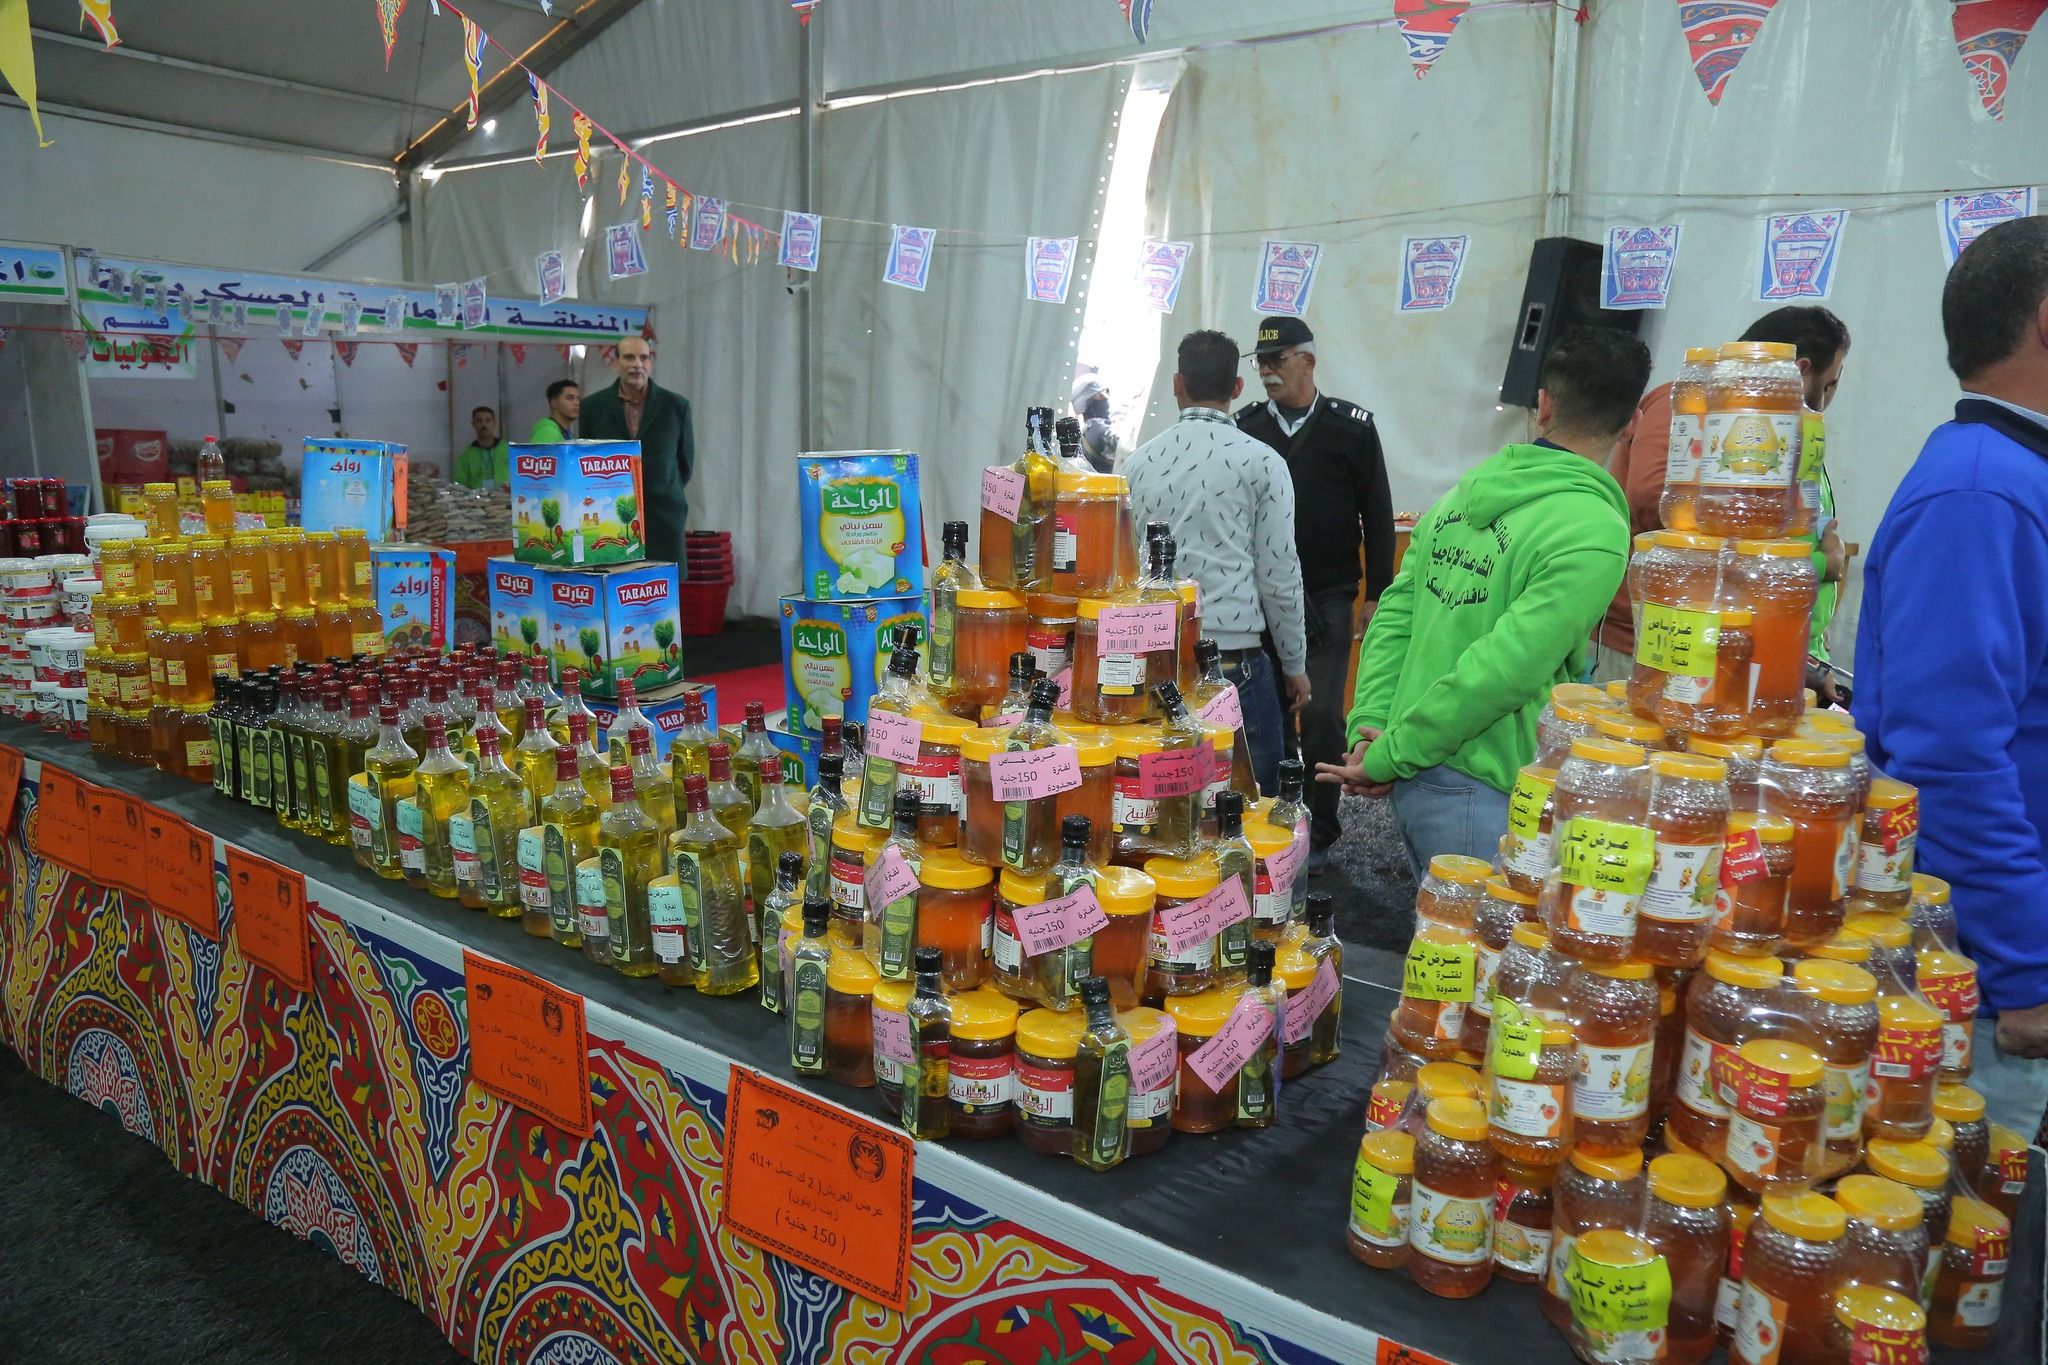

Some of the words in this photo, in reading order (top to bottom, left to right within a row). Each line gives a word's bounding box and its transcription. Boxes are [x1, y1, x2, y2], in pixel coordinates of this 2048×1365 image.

[103, 316, 169, 330] قسم
[507, 305, 629, 331] المنطقة
[521, 458, 553, 474] تبارك
[582, 458, 630, 473] TABARAK
[831, 487, 895, 512] الواحة
[839, 522, 860, 531] نباتي
[861, 522, 883, 531] سمن
[500, 576, 528, 591] تبارك
[557, 586, 588, 602] تبارك
[619, 583, 667, 600] TABARAK
[1109, 610, 1140, 620] خاص
[1142, 609, 1163, 619] عرض
[1153, 623, 1169, 633] لفترة
[799, 629, 841, 656] الواحة
[1147, 639, 1171, 648] محدودة
[804, 662, 818, 671] نباتي
[819, 664, 834, 672] سمن
[659, 703, 708, 730] TABAK
[884, 716, 909, 727] عرض
[901, 735, 914, 745] لفترة
[892, 749, 915, 761] محدودة
[998, 756, 1026, 767] خاص
[1029, 751, 1056, 764] عرض
[1151, 752, 1185, 763] خاص
[1052, 763, 1070, 775] لفترة
[1047, 780, 1077, 792] محدودة
[1589, 834, 1629, 850] عرض
[1674, 851, 1696, 860] HONEY
[884, 867, 900, 882] لفترة
[1596, 870, 1625, 884] محدودة
[885, 881, 912, 898] محدودة
[1205, 889, 1226, 908] عرض
[1220, 897, 1236, 912] لفترة
[1024, 907, 1051, 920] خاص
[1052, 900, 1078, 914] عرض
[1078, 904, 1096, 919] لفترة
[1171, 904, 1202, 921] خاص
[662, 915, 681, 923] محدودة
[1077, 916, 1107, 936] محدودة
[1218, 911, 1243, 928] محدودة
[1427, 952, 1462, 967] عرض
[1436, 970, 1462, 980] لفترة
[1436, 985, 1462, 995] محدودة
[1284, 994, 1309, 1015] خاص
[1225, 1013, 1243, 1039] عرض
[1245, 1013, 1262, 1031] لفترة
[1250, 1021, 1274, 1047] محدودة
[1504, 1029, 1528, 1041] لفترة
[1137, 1038, 1165, 1061] خاص
[1197, 1037, 1224, 1063] خاص
[1502, 1045, 1525, 1058] محدودة
[1601, 1053, 1622, 1062] HONEY
[1714, 1054, 1745, 1071] خاص
[1745, 1067, 1779, 1087] عرض
[1749, 1086, 1779, 1102] لفترة
[775, 1163, 792, 1179] عسل
[797, 1171, 806, 1184] ك
[808, 1178, 814, 1189] 2
[820, 1205, 839, 1221] زيت
[855, 1198, 884, 1217] عرض
[813, 1225, 837, 1247] 150
[1609, 1280, 1647, 1295] عرض
[1861, 1328, 1910, 1346] خاص
